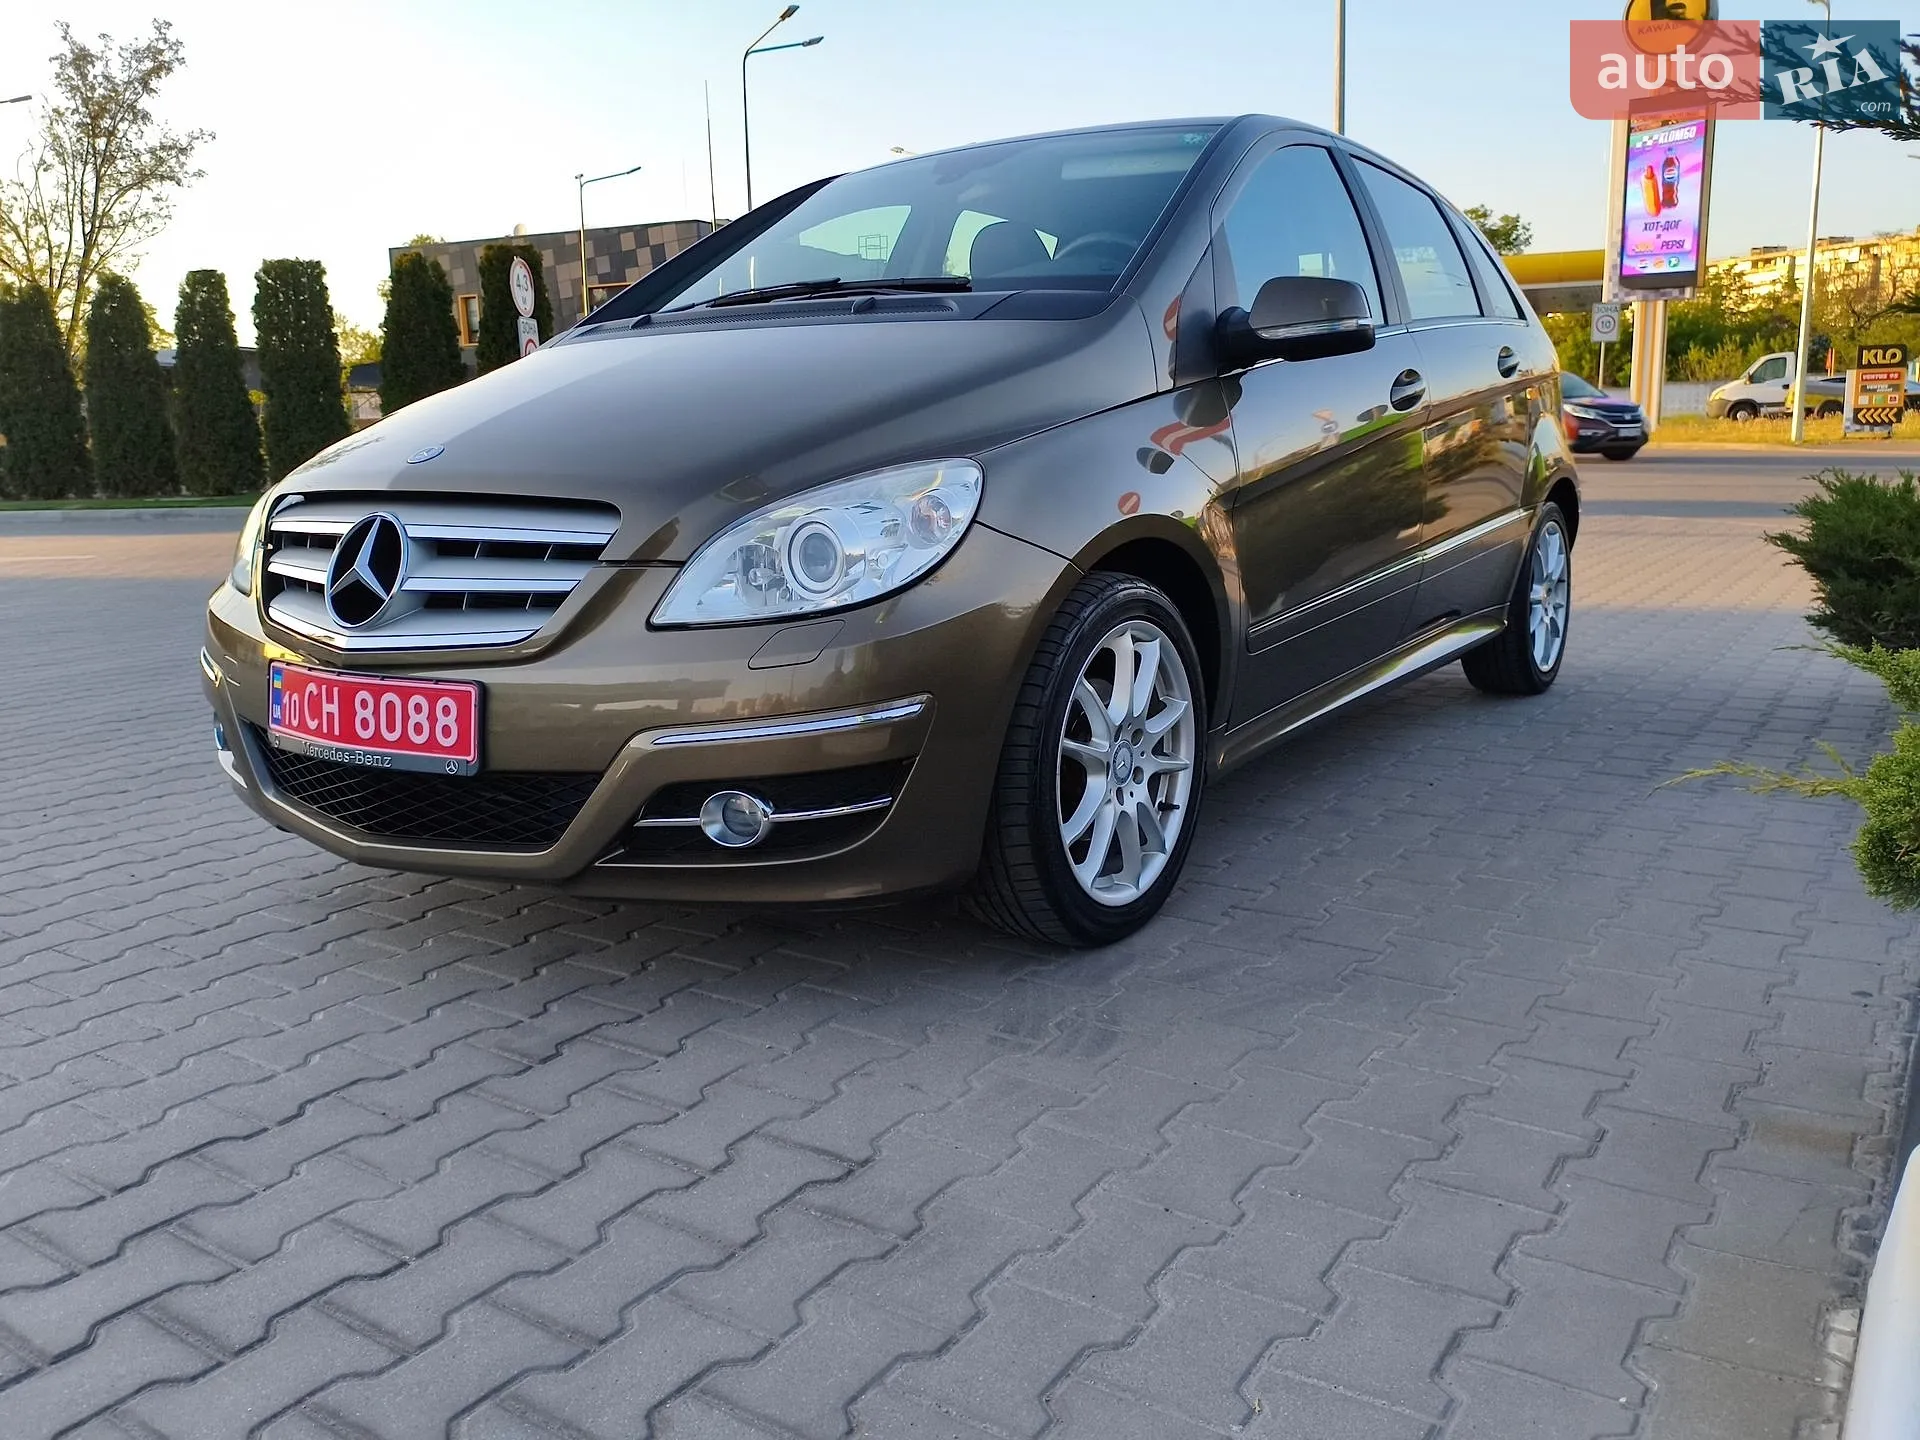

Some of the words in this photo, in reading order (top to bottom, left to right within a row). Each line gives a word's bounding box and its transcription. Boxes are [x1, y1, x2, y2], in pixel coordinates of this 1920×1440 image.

[1642, 220, 1682, 233] ХОТ-ДОГ
[1661, 240, 1685, 250] PEPSI
[1601, 320, 1611, 329] 10
[1862, 348, 1903, 365] KLO
[282, 690, 299, 727] 10
[354, 690, 458, 748] 8088
[301, 741, 392, 769] Mercedes-Benz
